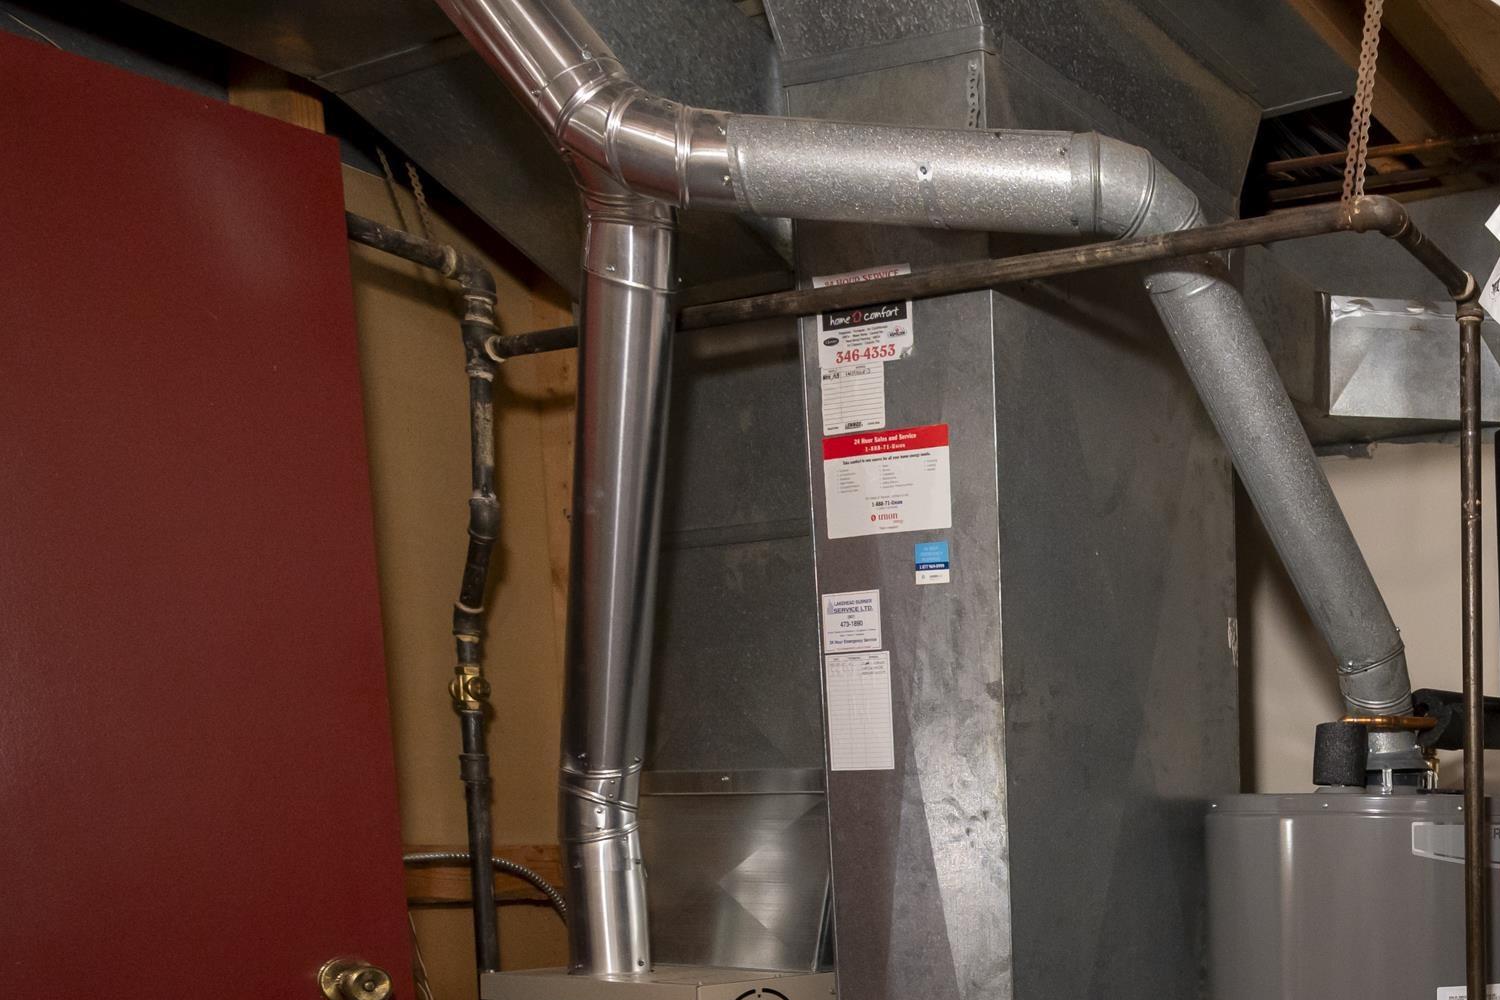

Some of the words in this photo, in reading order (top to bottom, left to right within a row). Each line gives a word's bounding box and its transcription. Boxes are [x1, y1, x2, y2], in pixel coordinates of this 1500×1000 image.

[830, 315, 851, 326] home
[863, 306, 900, 321] comfort
[836, 344, 896, 364] 346-4353
[874, 435, 888, 443] Sales
[899, 432, 917, 440] Service
